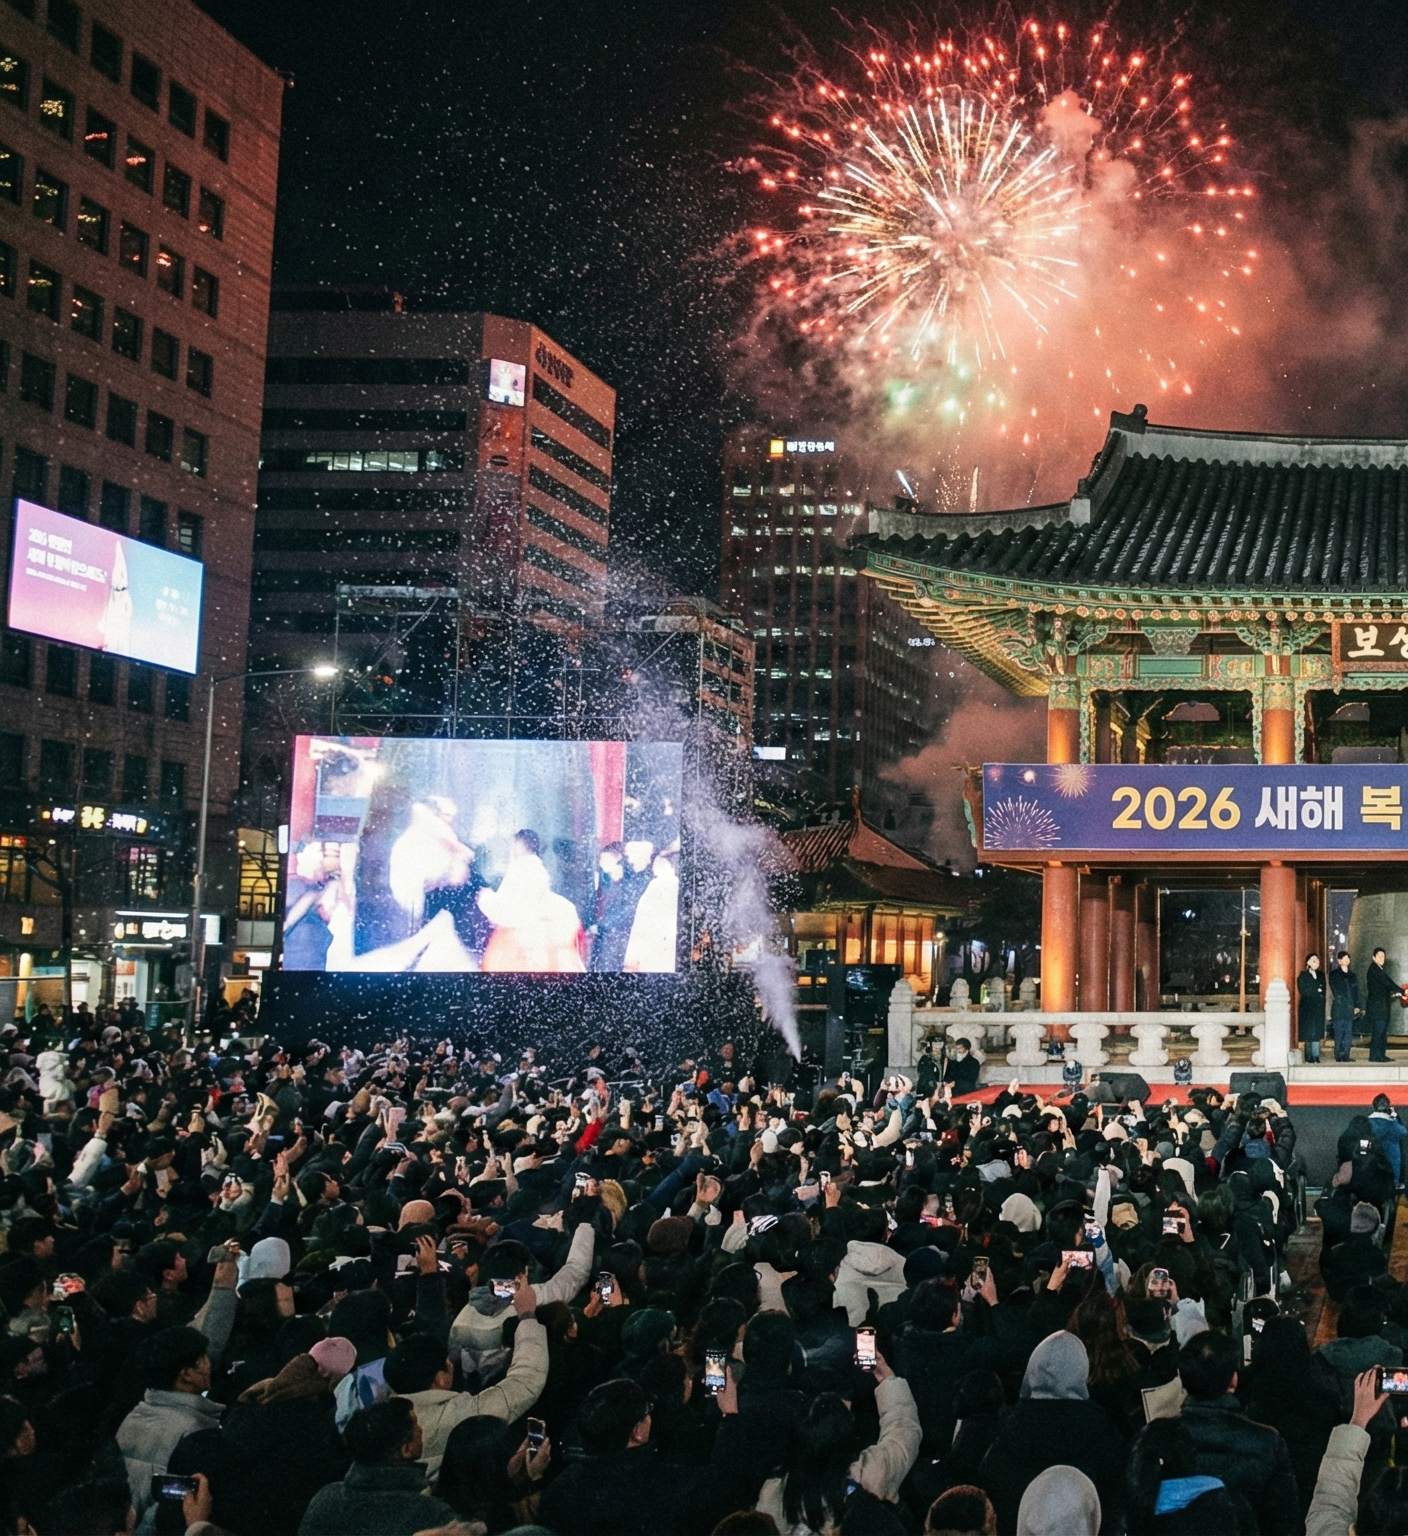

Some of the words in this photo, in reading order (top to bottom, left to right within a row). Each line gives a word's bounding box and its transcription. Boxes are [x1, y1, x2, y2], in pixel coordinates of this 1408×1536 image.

[1111, 786, 1241, 830] 2026
[1254, 785, 1344, 831] 새해
[1360, 785, 1403, 831] 복
